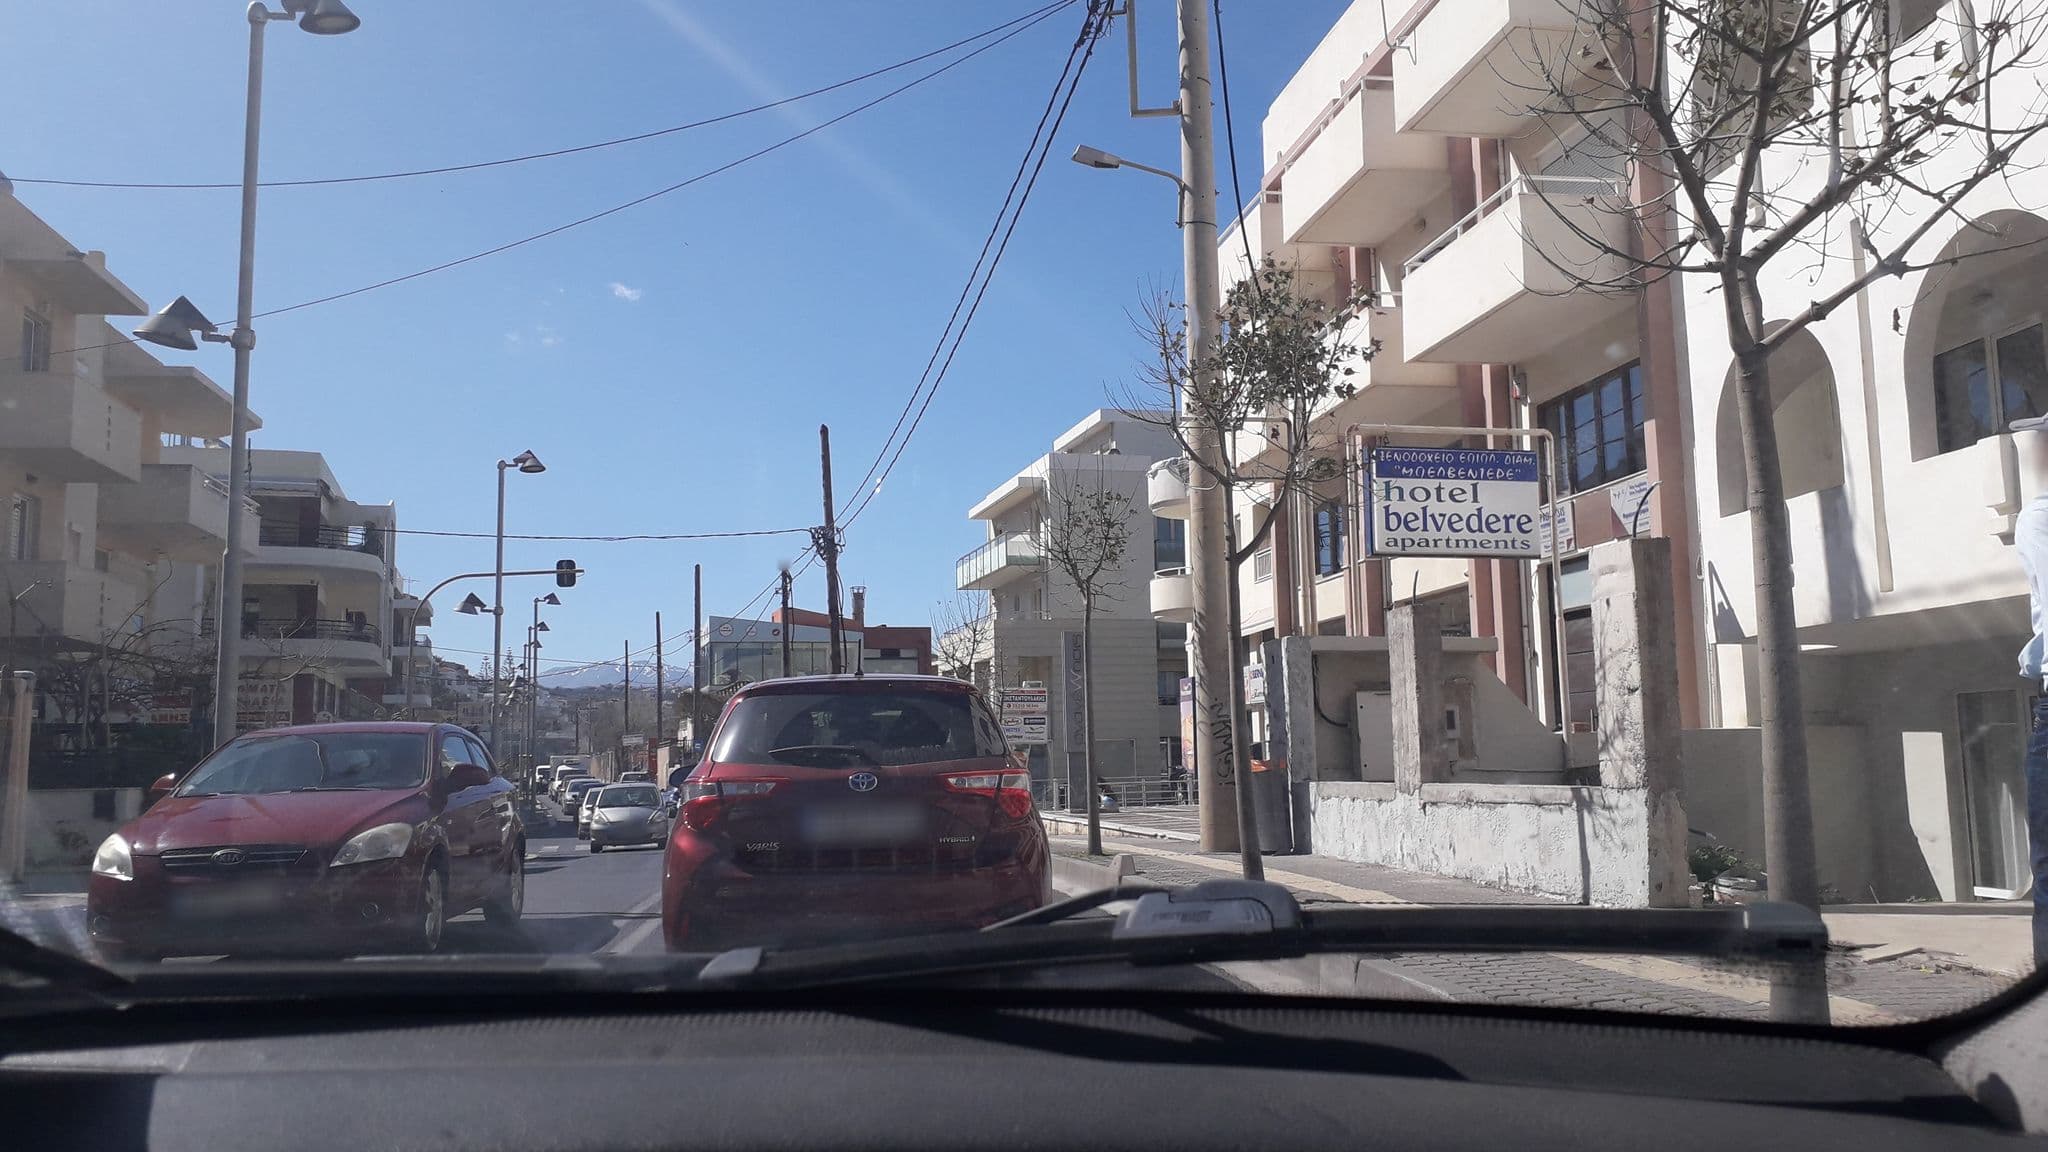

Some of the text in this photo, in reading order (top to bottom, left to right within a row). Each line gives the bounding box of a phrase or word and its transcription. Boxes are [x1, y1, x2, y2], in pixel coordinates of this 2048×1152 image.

[1380, 451, 1454, 463] ΞΕΝΟΔΟΧΕΙΟ
[1383, 480, 1480, 503] hotel
[1383, 504, 1533, 534] belvedere
[1384, 536, 1531, 551] apartments
[745, 841, 780, 851] YARIS
